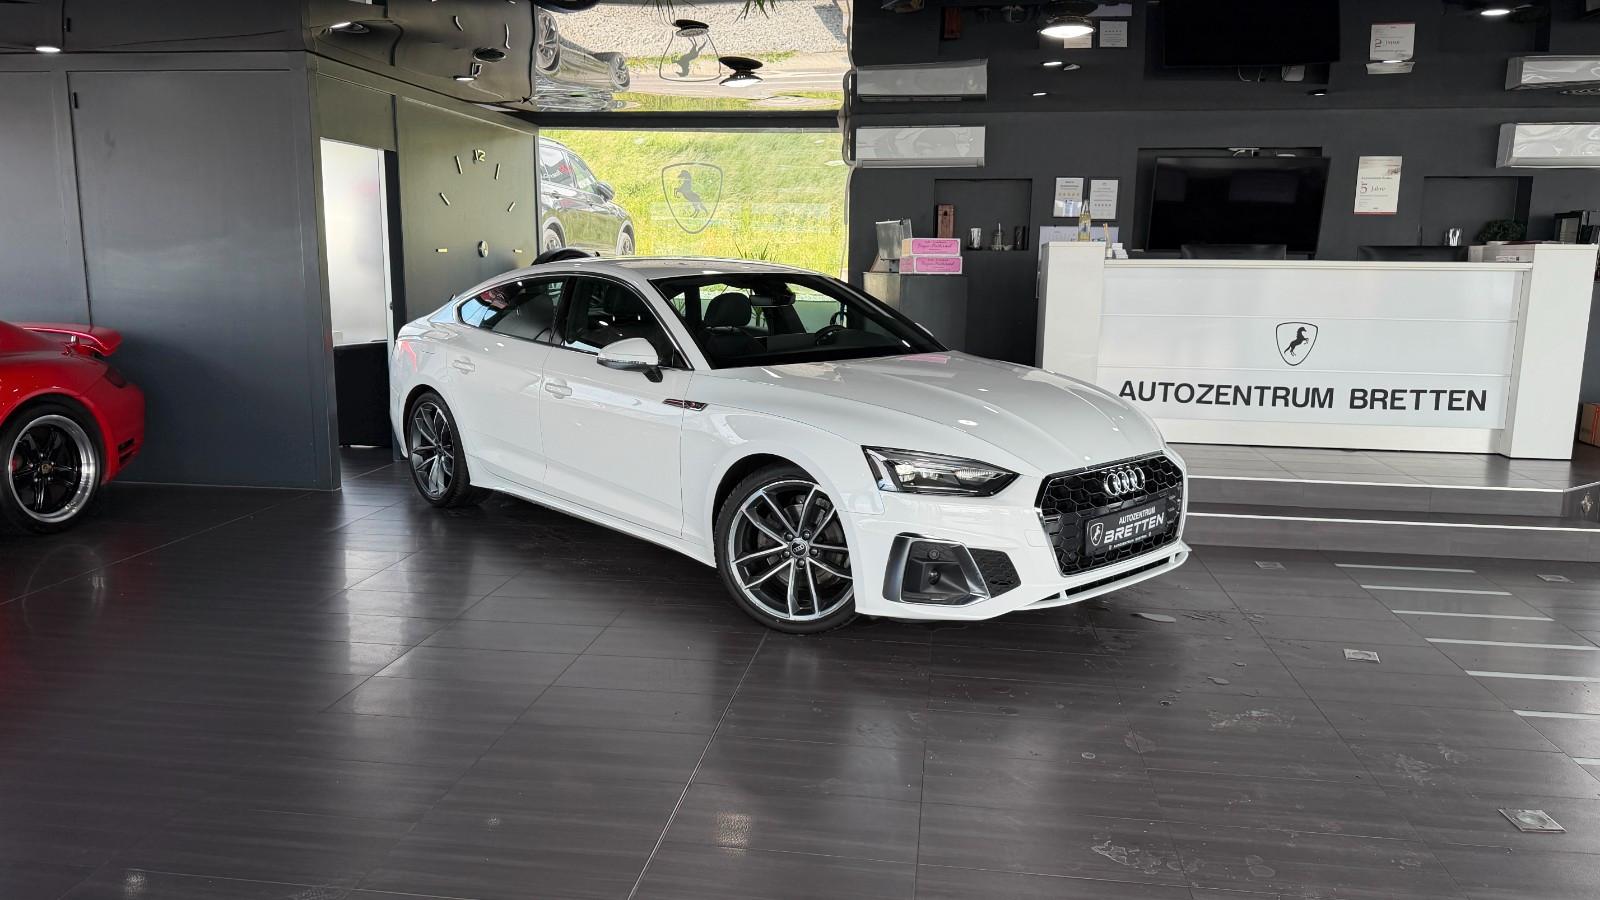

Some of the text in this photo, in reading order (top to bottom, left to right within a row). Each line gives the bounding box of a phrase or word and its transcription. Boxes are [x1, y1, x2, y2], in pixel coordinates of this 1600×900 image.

[474, 149, 486, 162] 12
[1360, 183, 1368, 194] 5
[1119, 380, 1487, 411] AUTOZENTRUM BRETTEN
[1118, 506, 1156, 525] AUTOZENTRUM
[1103, 512, 1165, 544] BRETTEN
